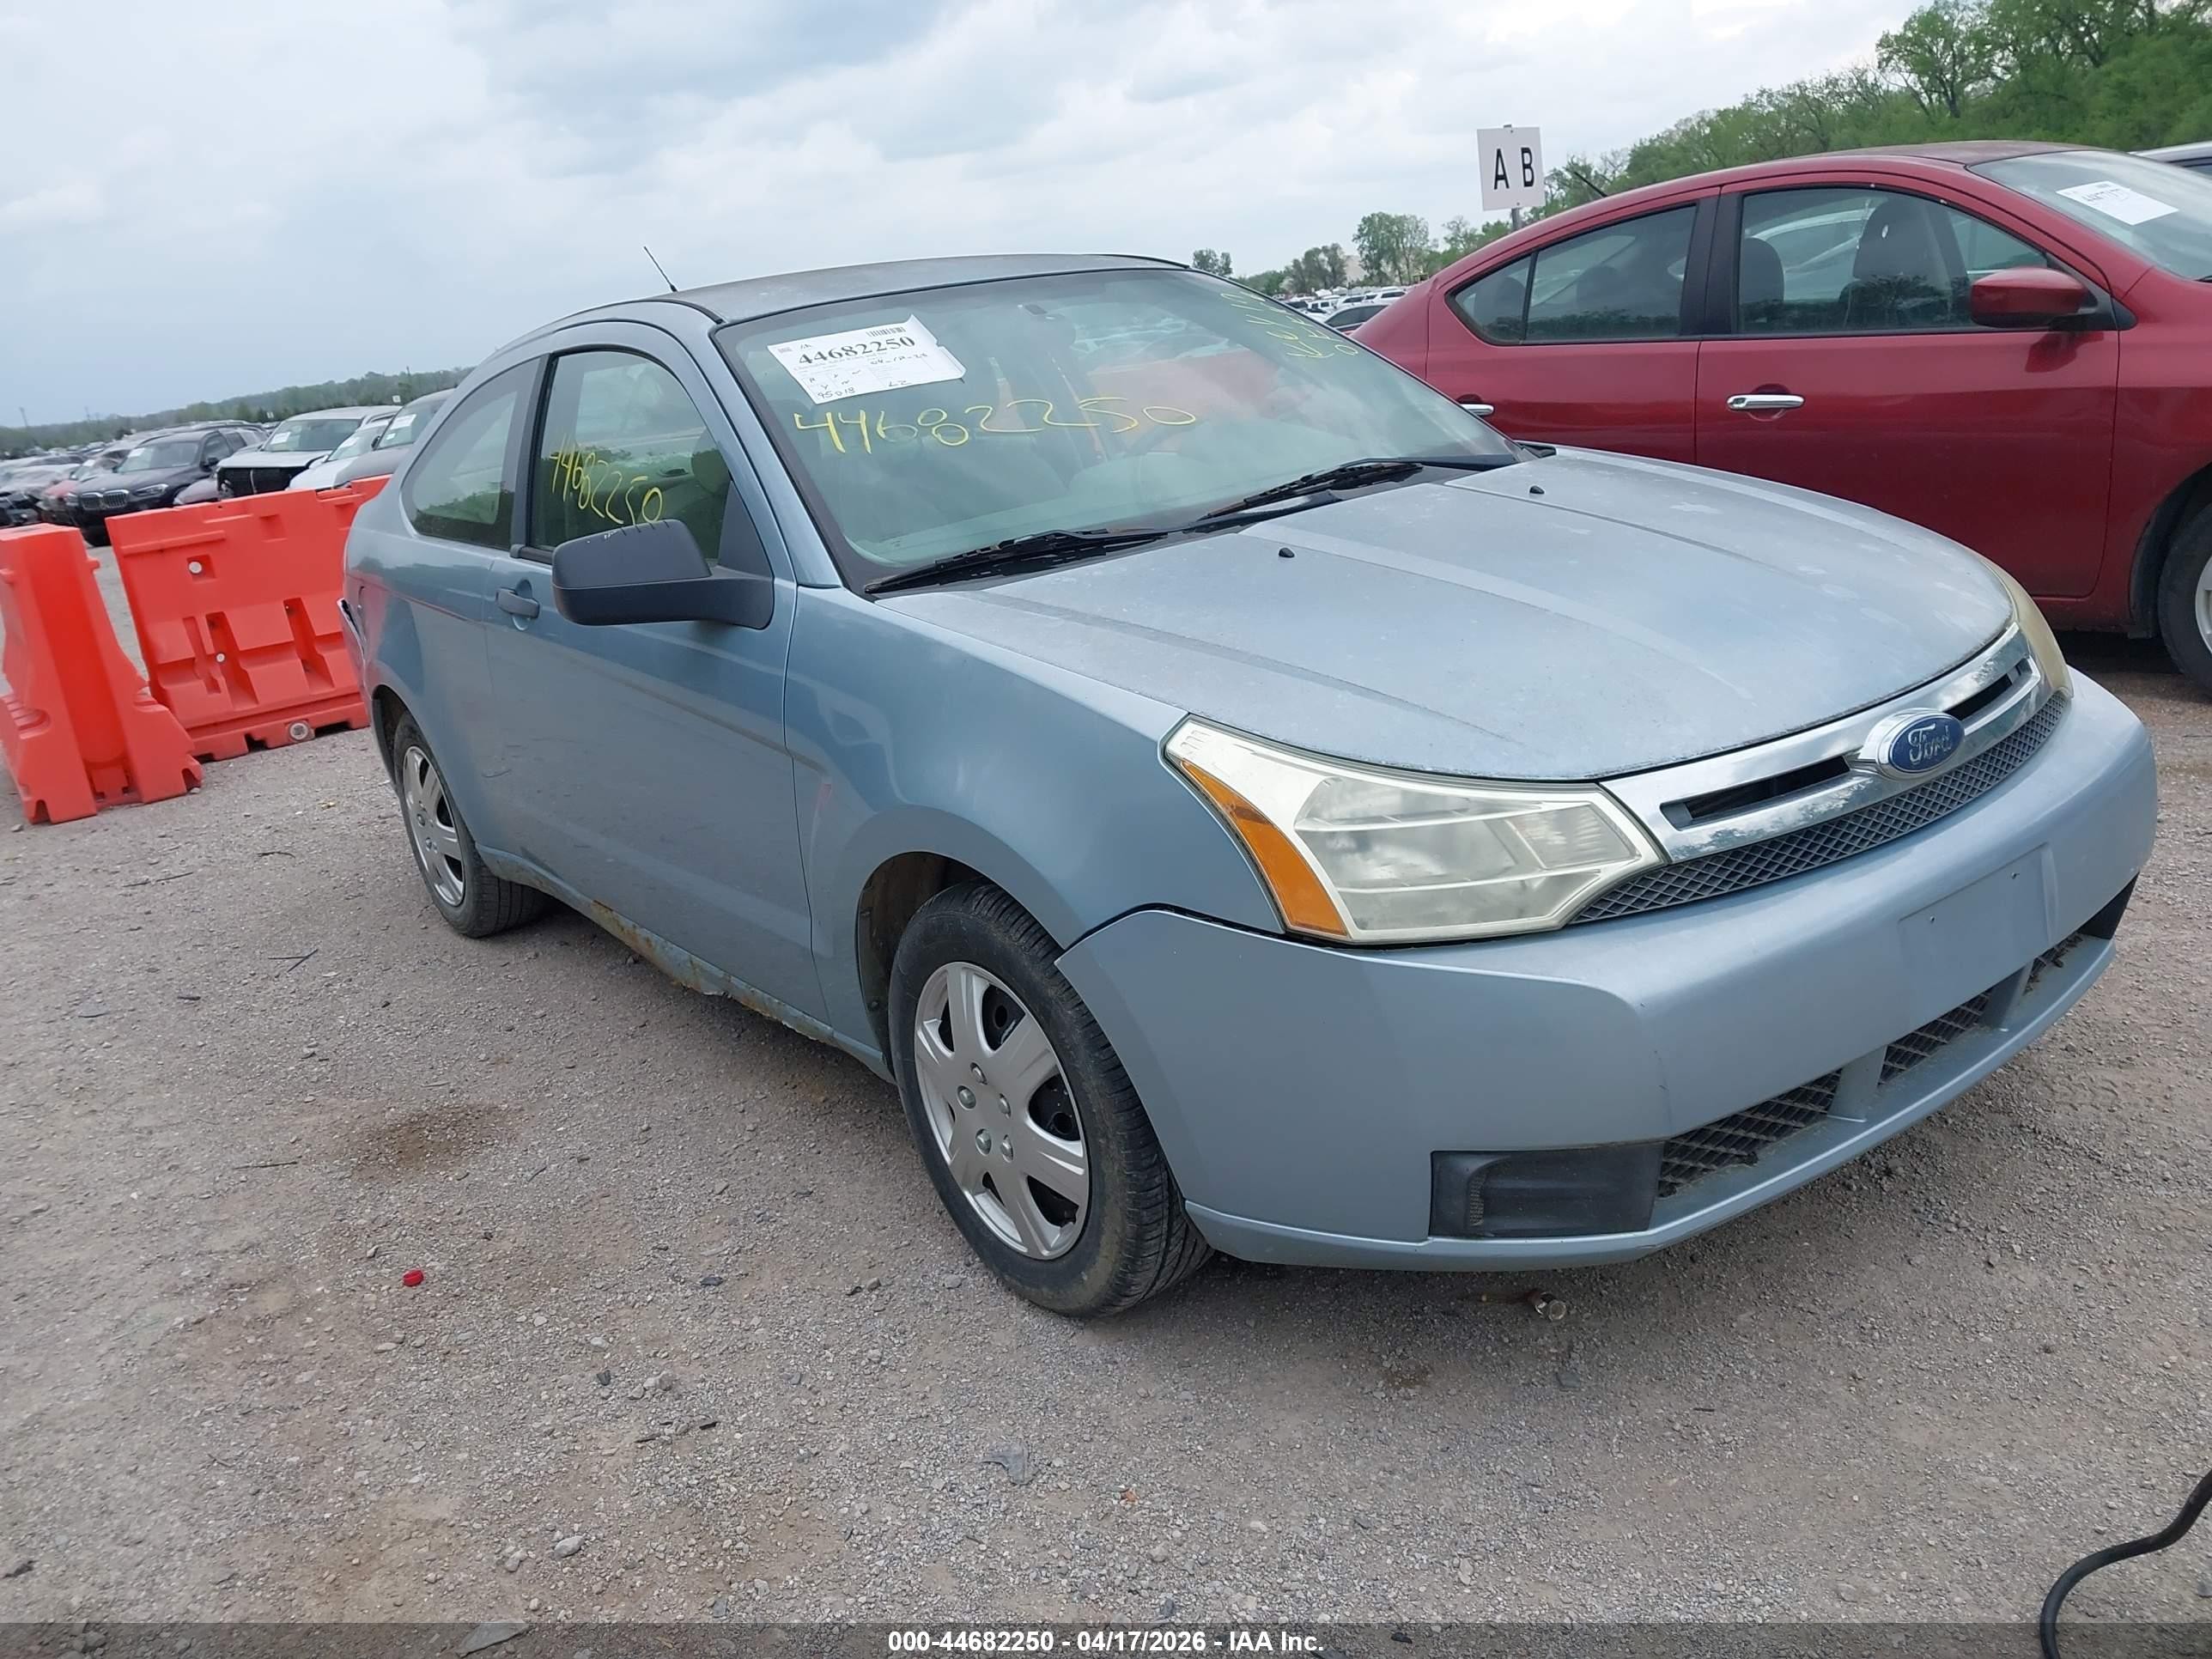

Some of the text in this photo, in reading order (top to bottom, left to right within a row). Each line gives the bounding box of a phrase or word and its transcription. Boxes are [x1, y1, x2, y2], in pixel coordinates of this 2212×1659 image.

[1493, 147, 1534, 190] A B
[798, 336, 915, 364] 44682250
[793, 397, 1196, 454] 44682250
[1907, 723, 1952, 764] Ford
